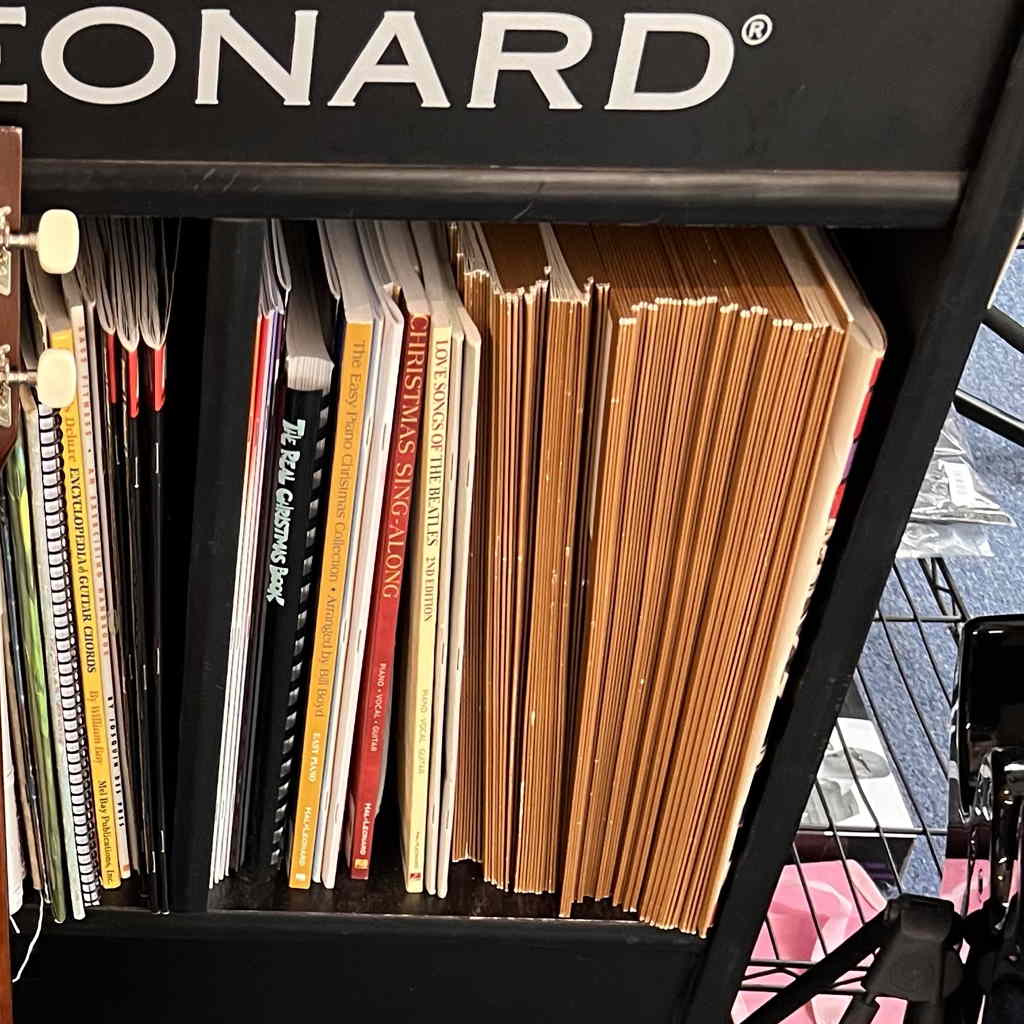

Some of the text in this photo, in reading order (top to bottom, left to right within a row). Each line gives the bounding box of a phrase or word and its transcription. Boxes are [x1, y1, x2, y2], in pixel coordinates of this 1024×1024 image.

[382, 311, 428, 598] CHRISTMAS SING-ALONG
[423, 340, 447, 622] LOVE SONGS OF THE BEATLES 2ND EDITION
[69, 467, 86, 564] ENCYCLOPEDIA
[314, 339, 365, 717] The Easy Piano Christmas Collection Arranged by Bill Boyd
[78, 575, 90, 621] GUITAR
[83, 625, 96, 673] CHORDS
[370, 662, 387, 752] PIANO VOCAL GUITAR
[98, 780, 107, 794] Mel
[98, 797, 109, 813] Bay
